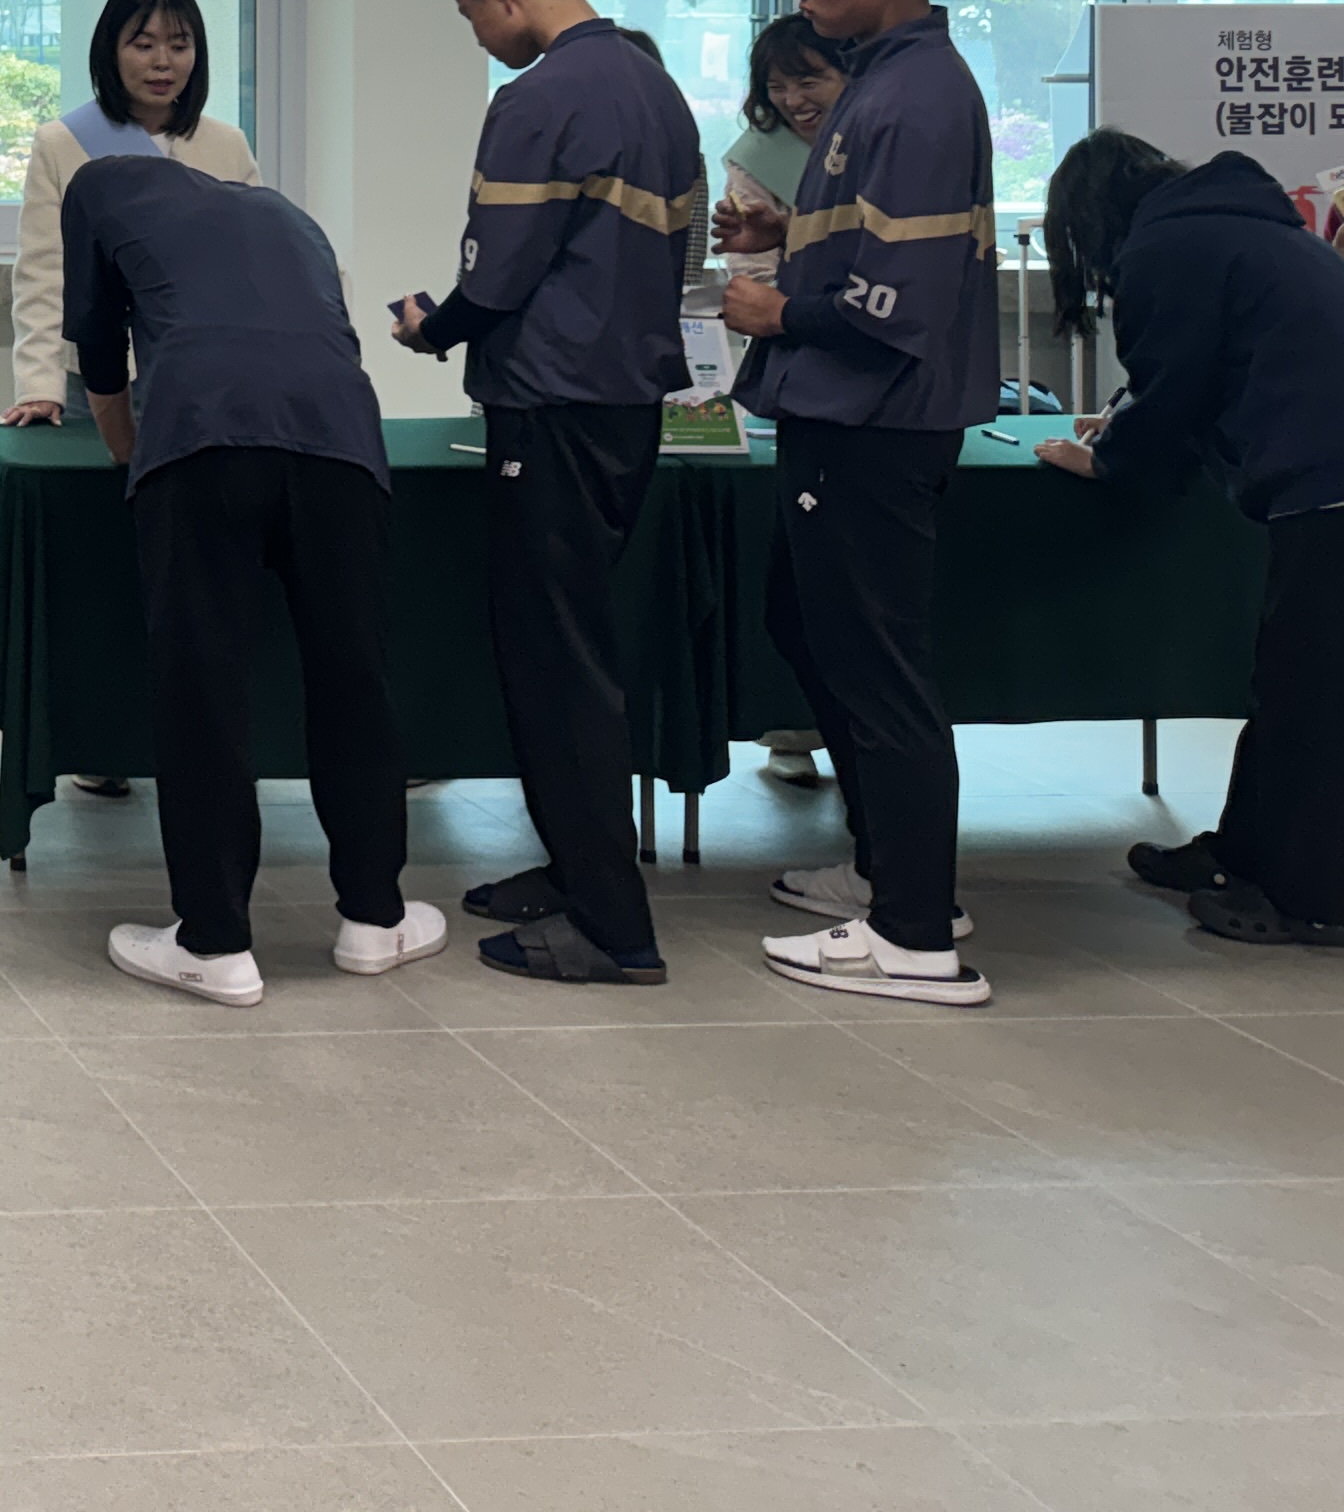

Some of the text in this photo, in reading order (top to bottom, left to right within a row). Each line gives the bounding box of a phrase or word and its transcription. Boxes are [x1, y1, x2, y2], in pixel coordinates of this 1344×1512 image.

[1217, 29, 1273, 51] 체험형
[1215, 55, 1344, 93] 안전훈련
[464, 238, 479, 272] 9
[843, 272, 898, 320] 20
